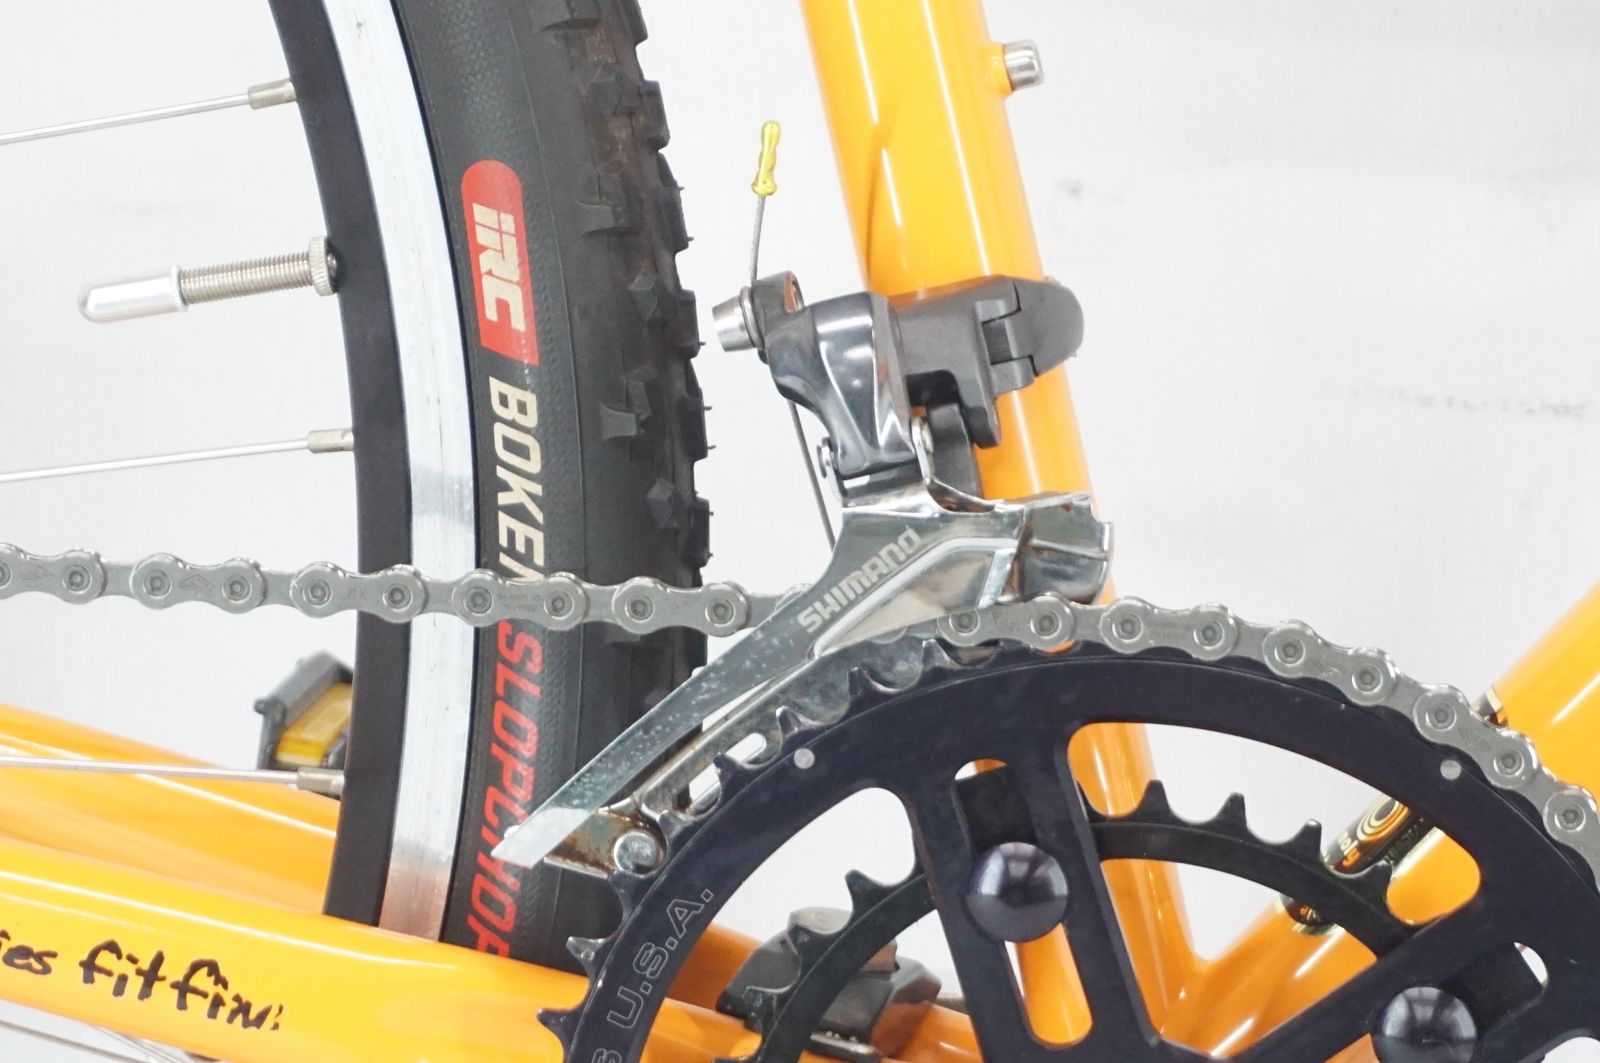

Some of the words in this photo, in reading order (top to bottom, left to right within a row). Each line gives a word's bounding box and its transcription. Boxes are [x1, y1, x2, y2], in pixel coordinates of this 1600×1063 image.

[797, 525, 921, 633] SHIMANO
[79, 939, 167, 1001] fit
[607, 888, 714, 1030] U.S.A.
